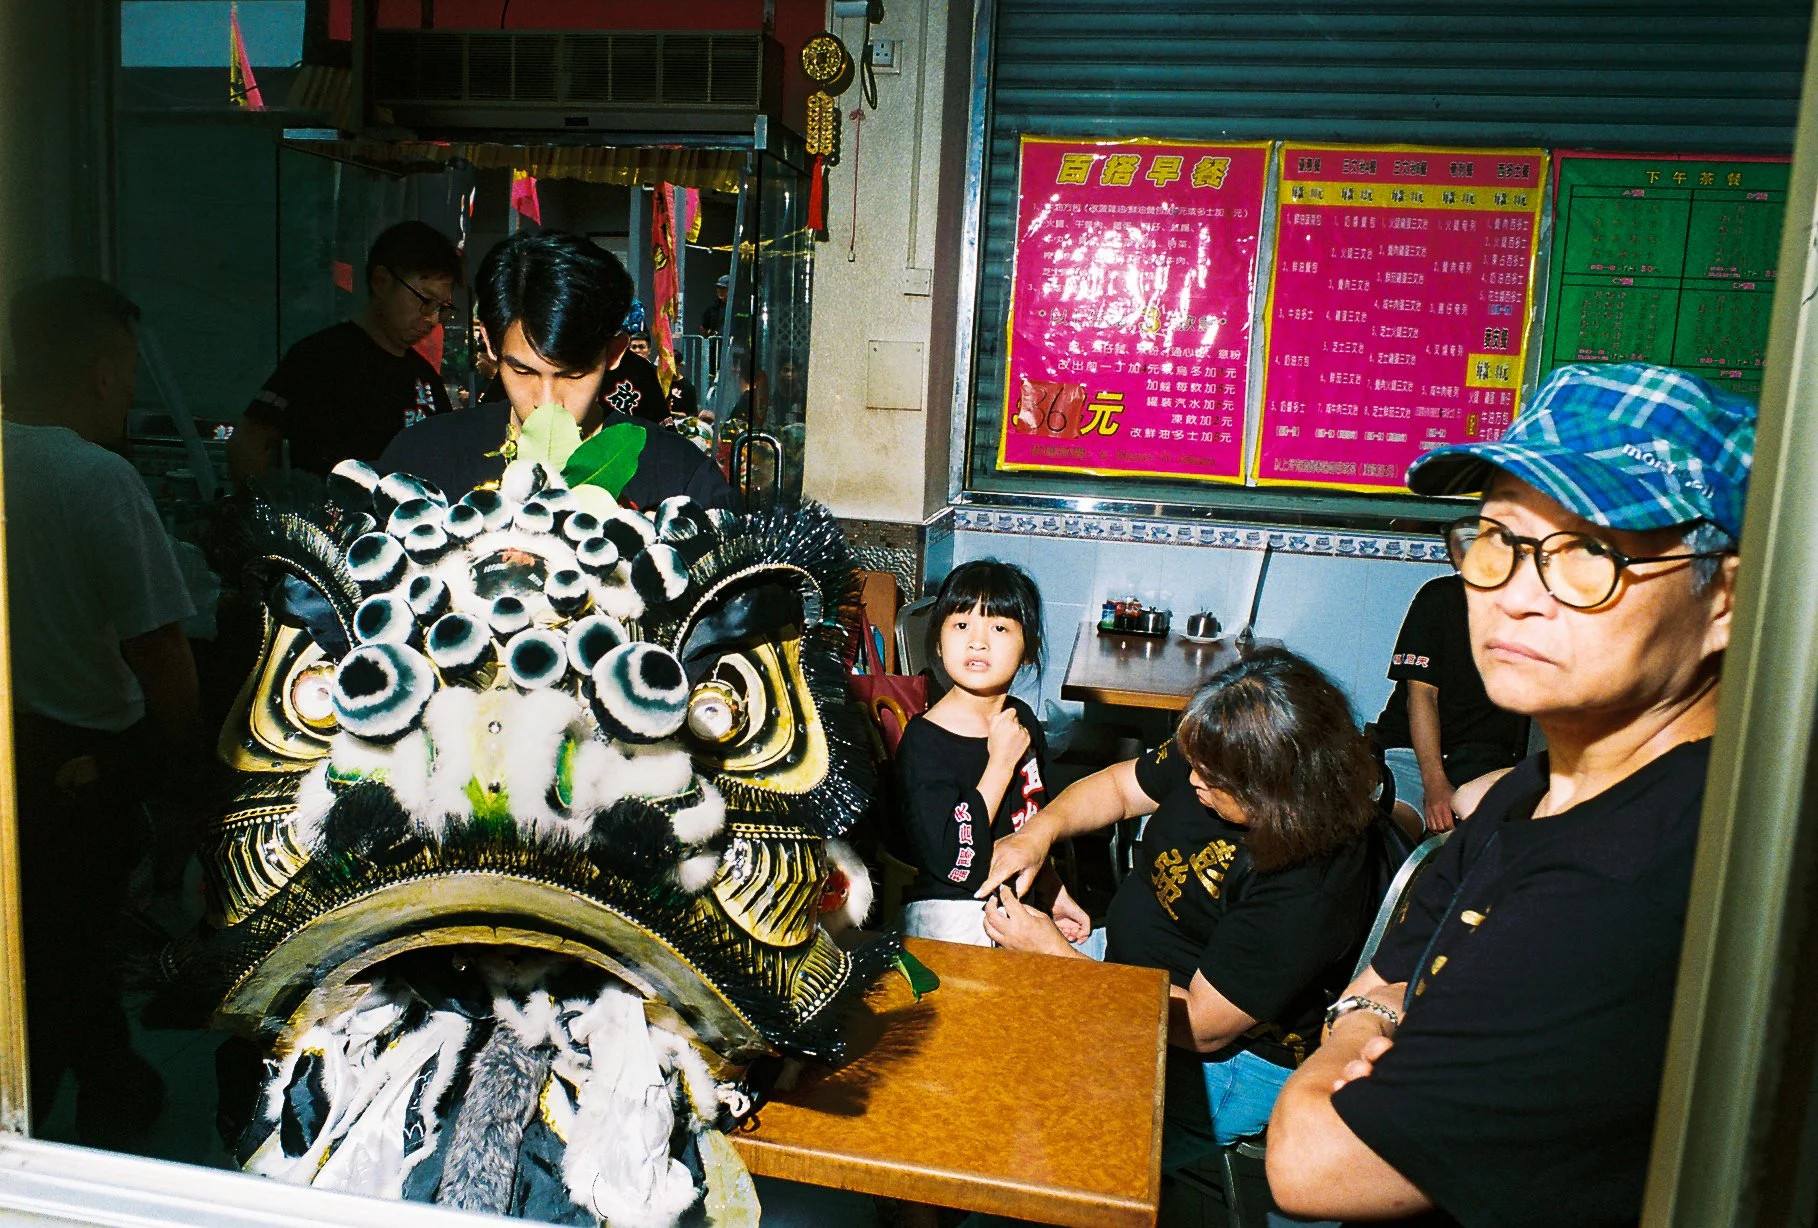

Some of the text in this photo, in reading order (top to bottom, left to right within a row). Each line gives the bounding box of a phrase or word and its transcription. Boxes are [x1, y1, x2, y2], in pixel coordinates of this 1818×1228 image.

[1056, 153, 1231, 189] 百搭早餐
[1646, 170, 1743, 186] 下午茶餐
